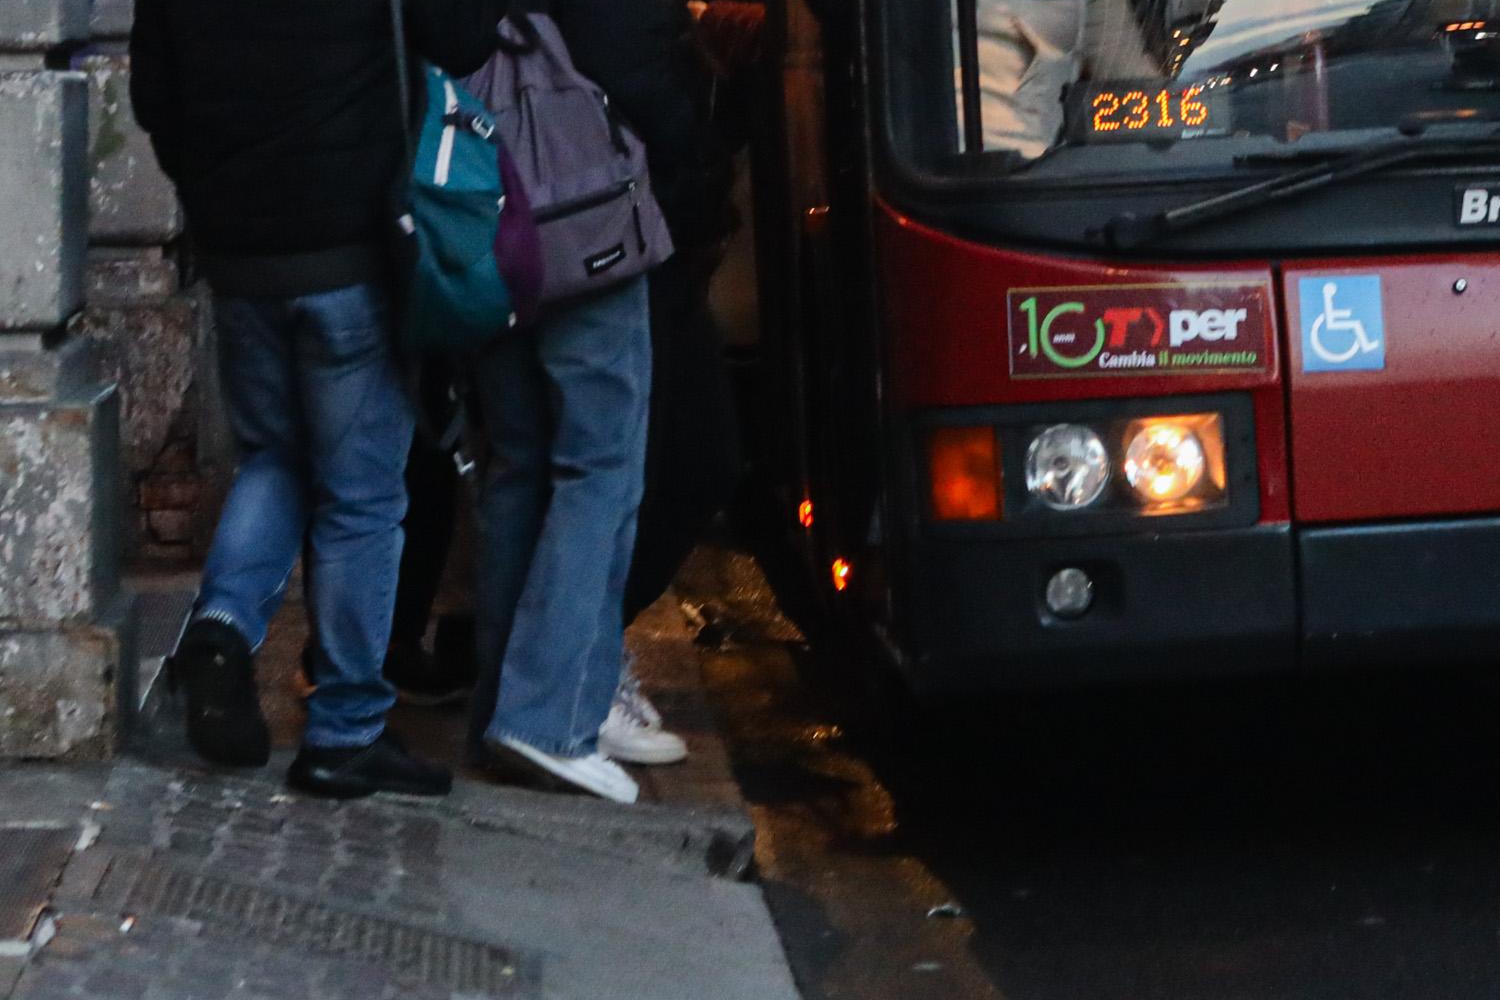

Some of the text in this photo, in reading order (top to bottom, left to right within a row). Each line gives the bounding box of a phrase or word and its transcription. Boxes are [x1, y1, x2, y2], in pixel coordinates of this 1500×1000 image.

[1092, 86, 1208, 131] 2316
[1098, 350, 1257, 369] Cambia il movimento
